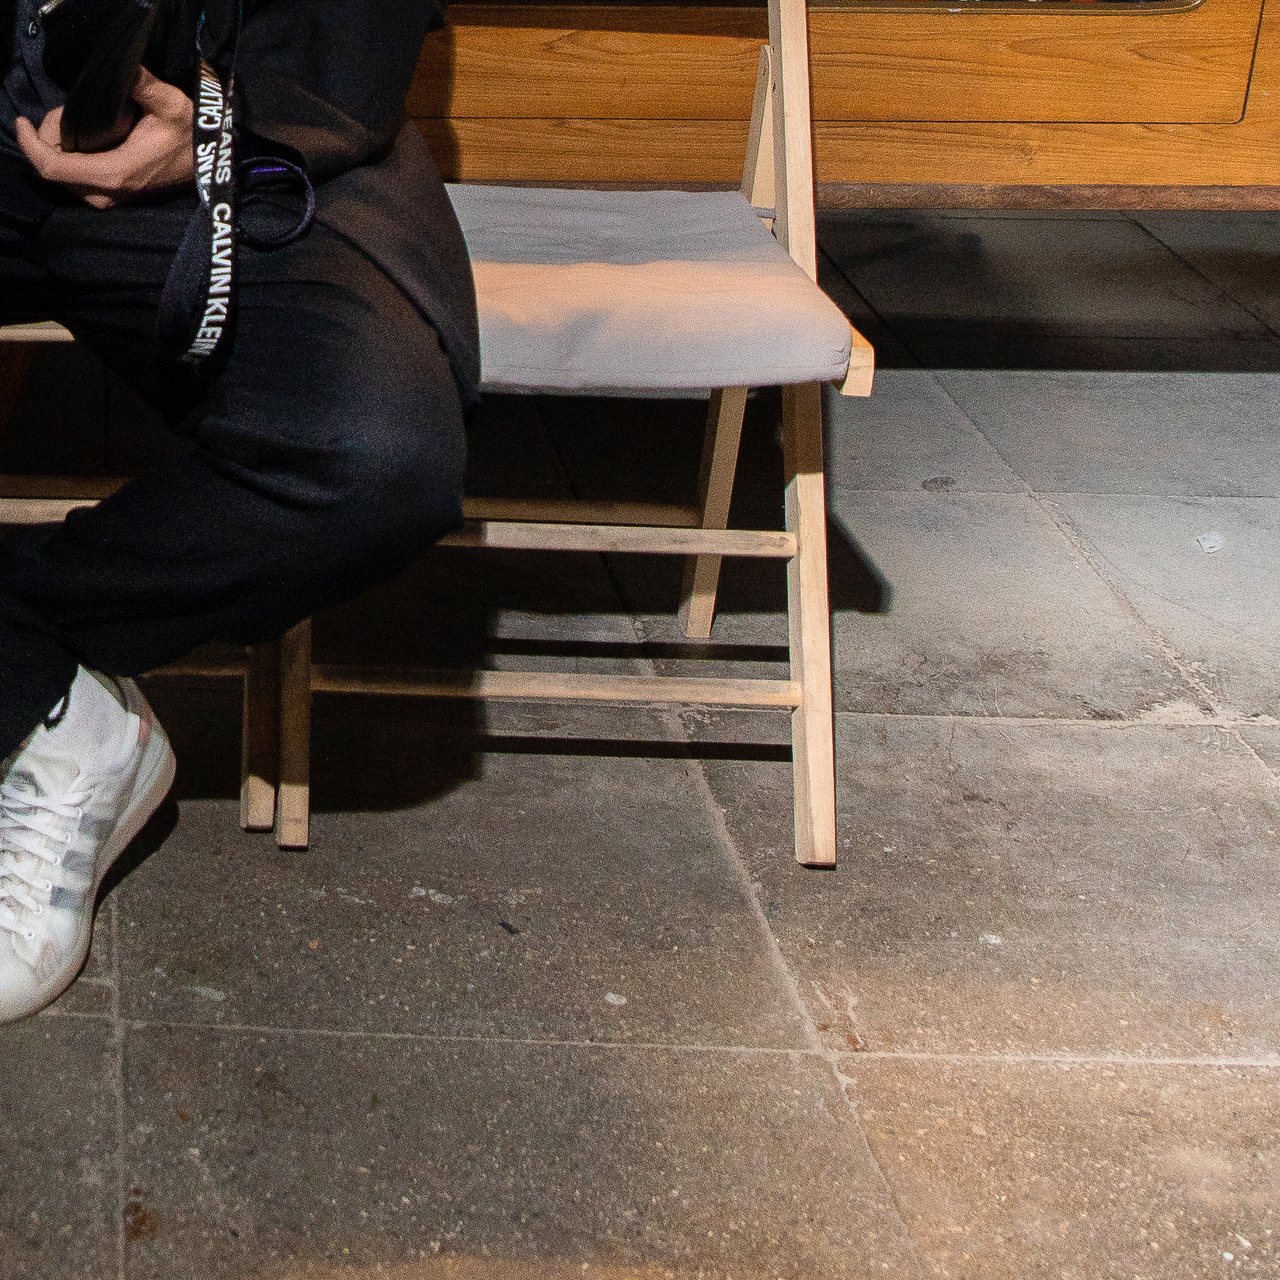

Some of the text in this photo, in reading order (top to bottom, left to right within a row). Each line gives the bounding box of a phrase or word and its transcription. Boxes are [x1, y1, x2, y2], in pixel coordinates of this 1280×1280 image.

[197, 142, 217, 201] ANS
[209, 202, 232, 294] CALVIN
[187, 297, 230, 356] KLEIN
